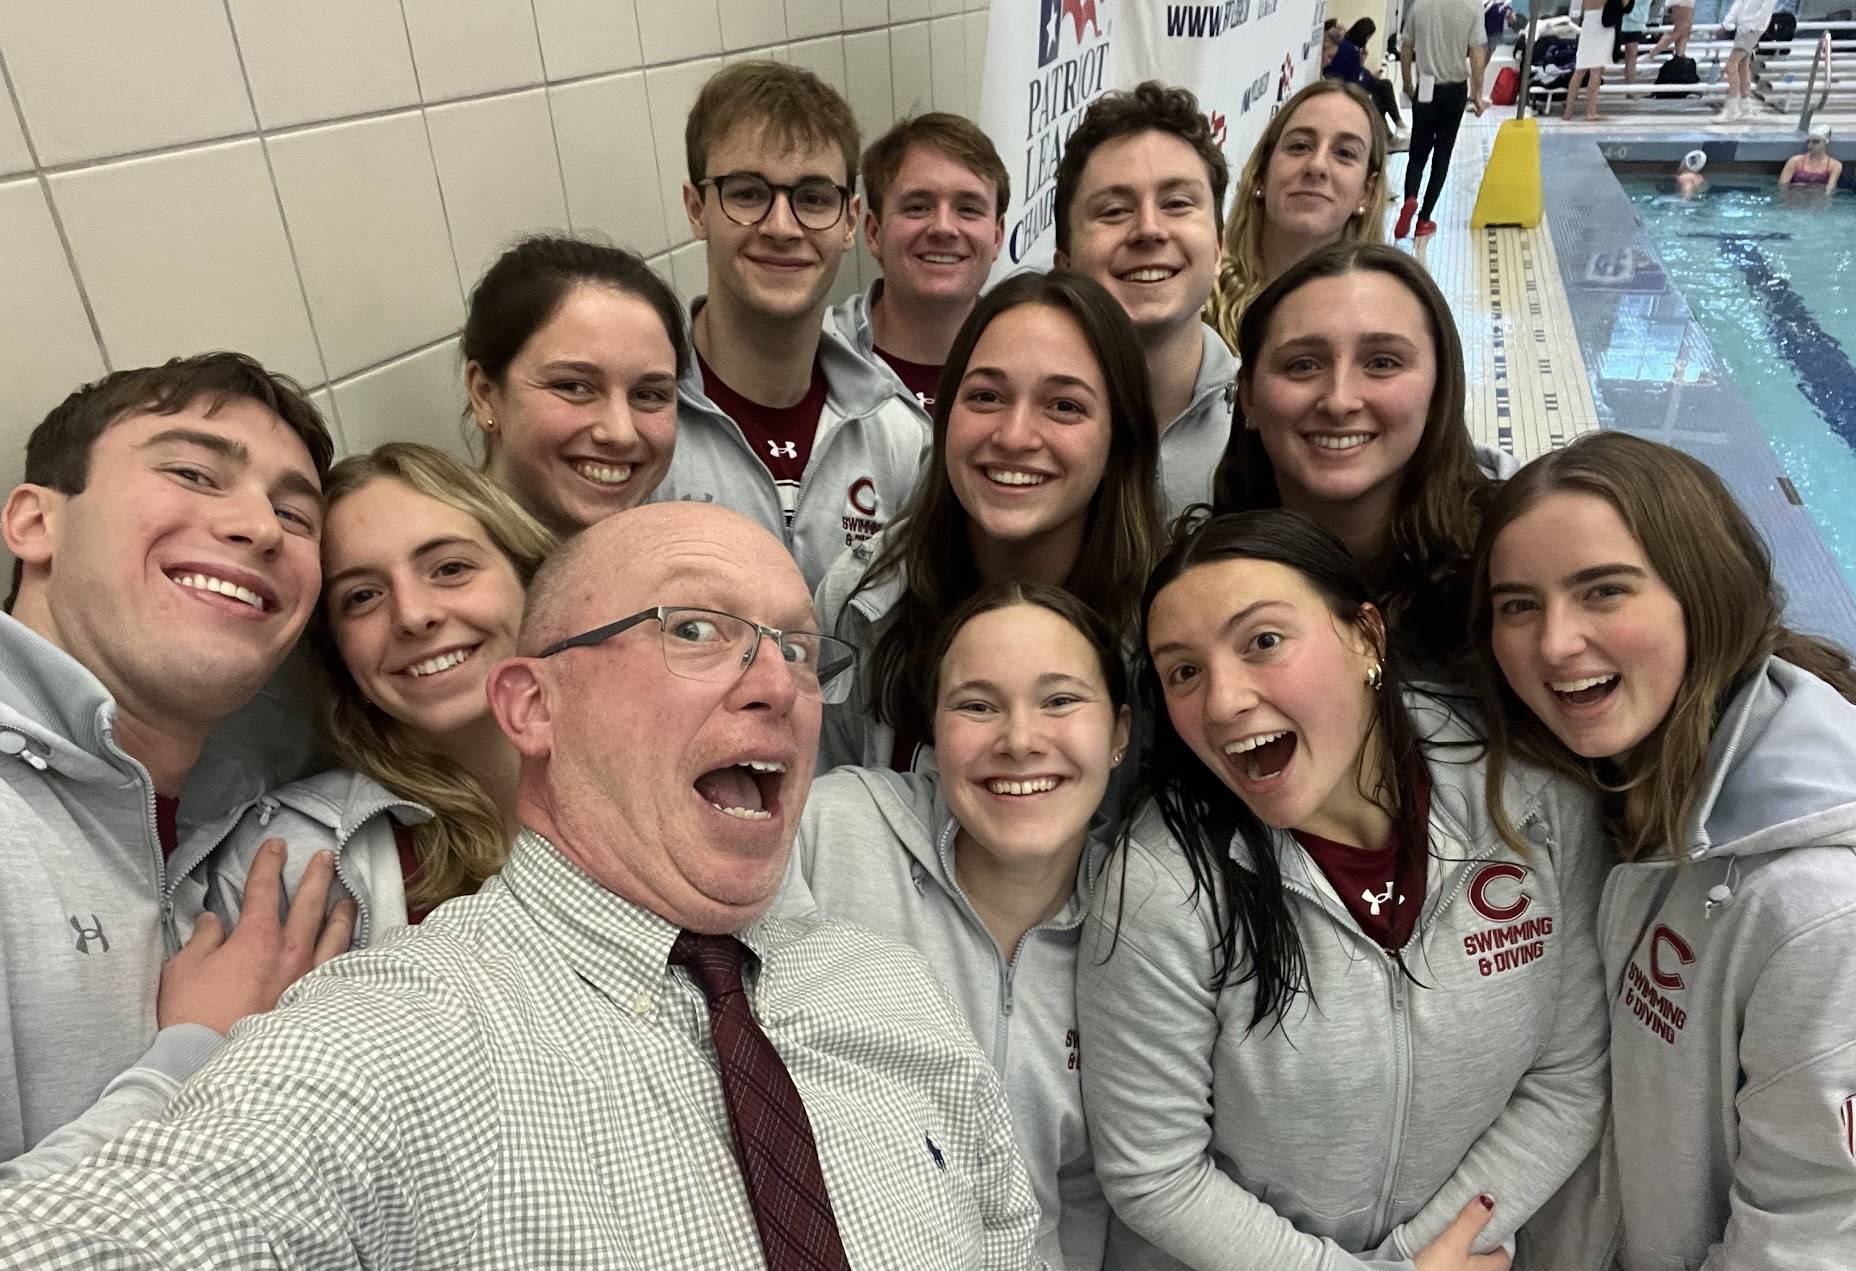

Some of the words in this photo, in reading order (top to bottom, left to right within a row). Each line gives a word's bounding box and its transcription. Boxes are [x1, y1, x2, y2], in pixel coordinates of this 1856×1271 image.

[1026, 42, 1110, 141] PATRIOT
[1023, 106, 1089, 206] LEA
[842, 516, 883, 536] SWIMM
[848, 476, 877, 518] C
[1467, 863, 1532, 923] C
[1463, 916, 1553, 956] SWIMMING
[1478, 957, 1493, 977] &
[1493, 941, 1545, 973] DIVING
[1650, 923, 1696, 990] C
[1625, 986, 1636, 1007] &
[1633, 998, 1676, 1045] DIVING
[1628, 961, 1688, 1031] SWIMMING
